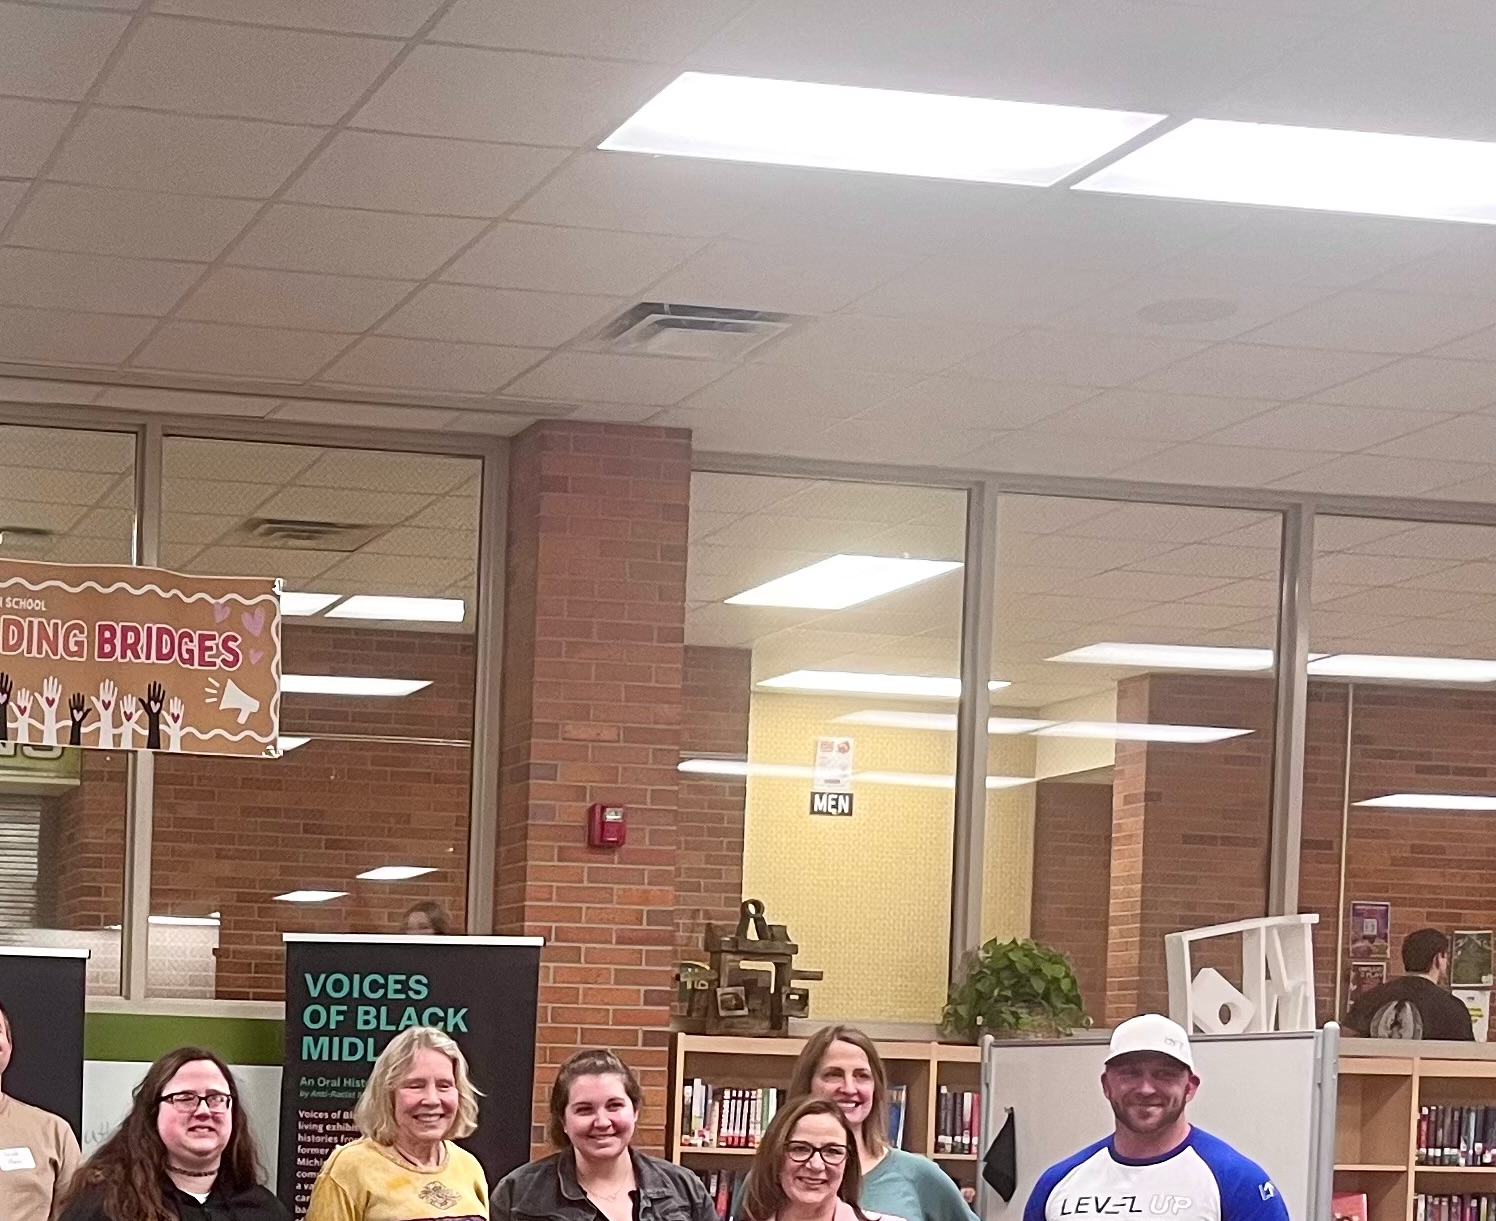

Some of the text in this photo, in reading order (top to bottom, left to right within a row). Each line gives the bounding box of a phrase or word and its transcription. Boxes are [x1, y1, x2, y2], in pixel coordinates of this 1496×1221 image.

[5, 596, 47, 611] SCHOOL
[95, 622, 242, 671] BRIDGES
[813, 793, 850, 814] MEN
[304, 973, 429, 1000] VOICES
[303, 1004, 469, 1033] OF BLACK
[299, 1076, 315, 1087] An
[317, 1077, 341, 1087] Oral
[298, 1109, 329, 1119] Voices
[330, 1110, 341, 1119] of
[298, 1121, 324, 1133] living
[297, 1133, 339, 1143] histories
[297, 1144, 329, 1154] former
[1149, 1193, 1193, 1216] UP
